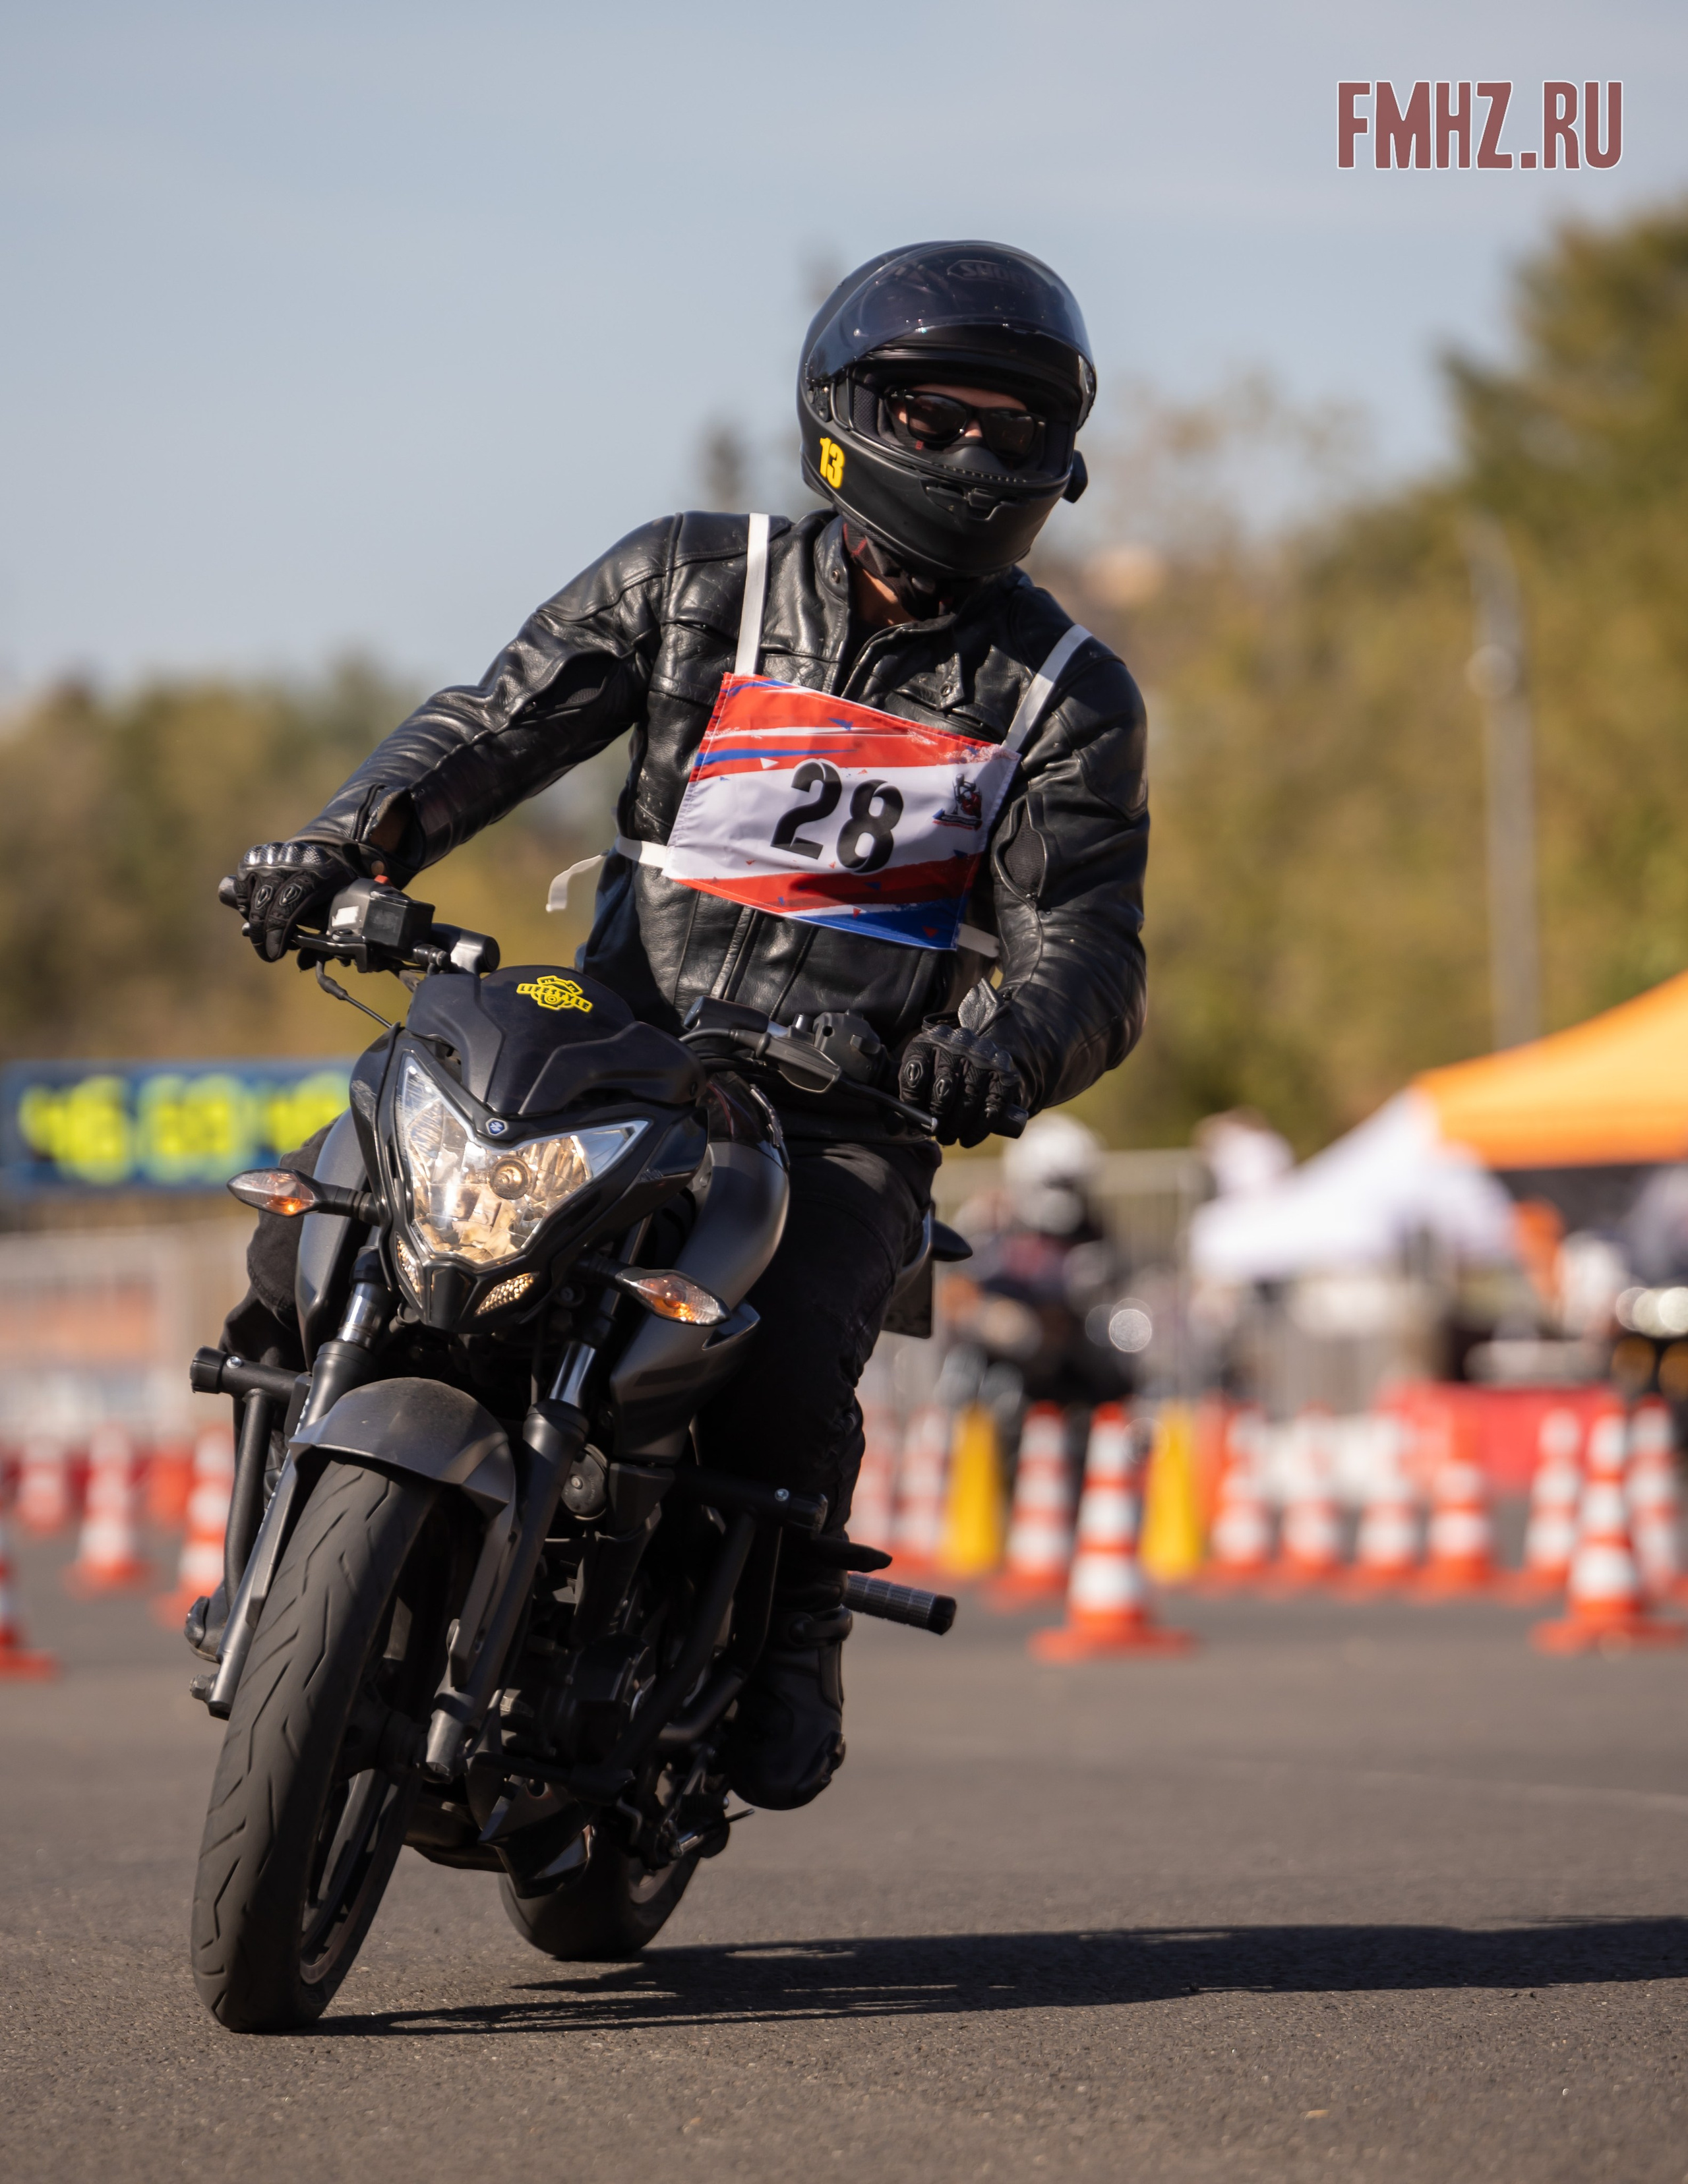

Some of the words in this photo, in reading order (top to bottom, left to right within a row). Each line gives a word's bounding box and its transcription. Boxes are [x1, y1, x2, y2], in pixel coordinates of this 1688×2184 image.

[820, 437, 845, 488] 13
[770, 761, 904, 873] 28
[520, 985, 590, 1011] LIFESTYLE
